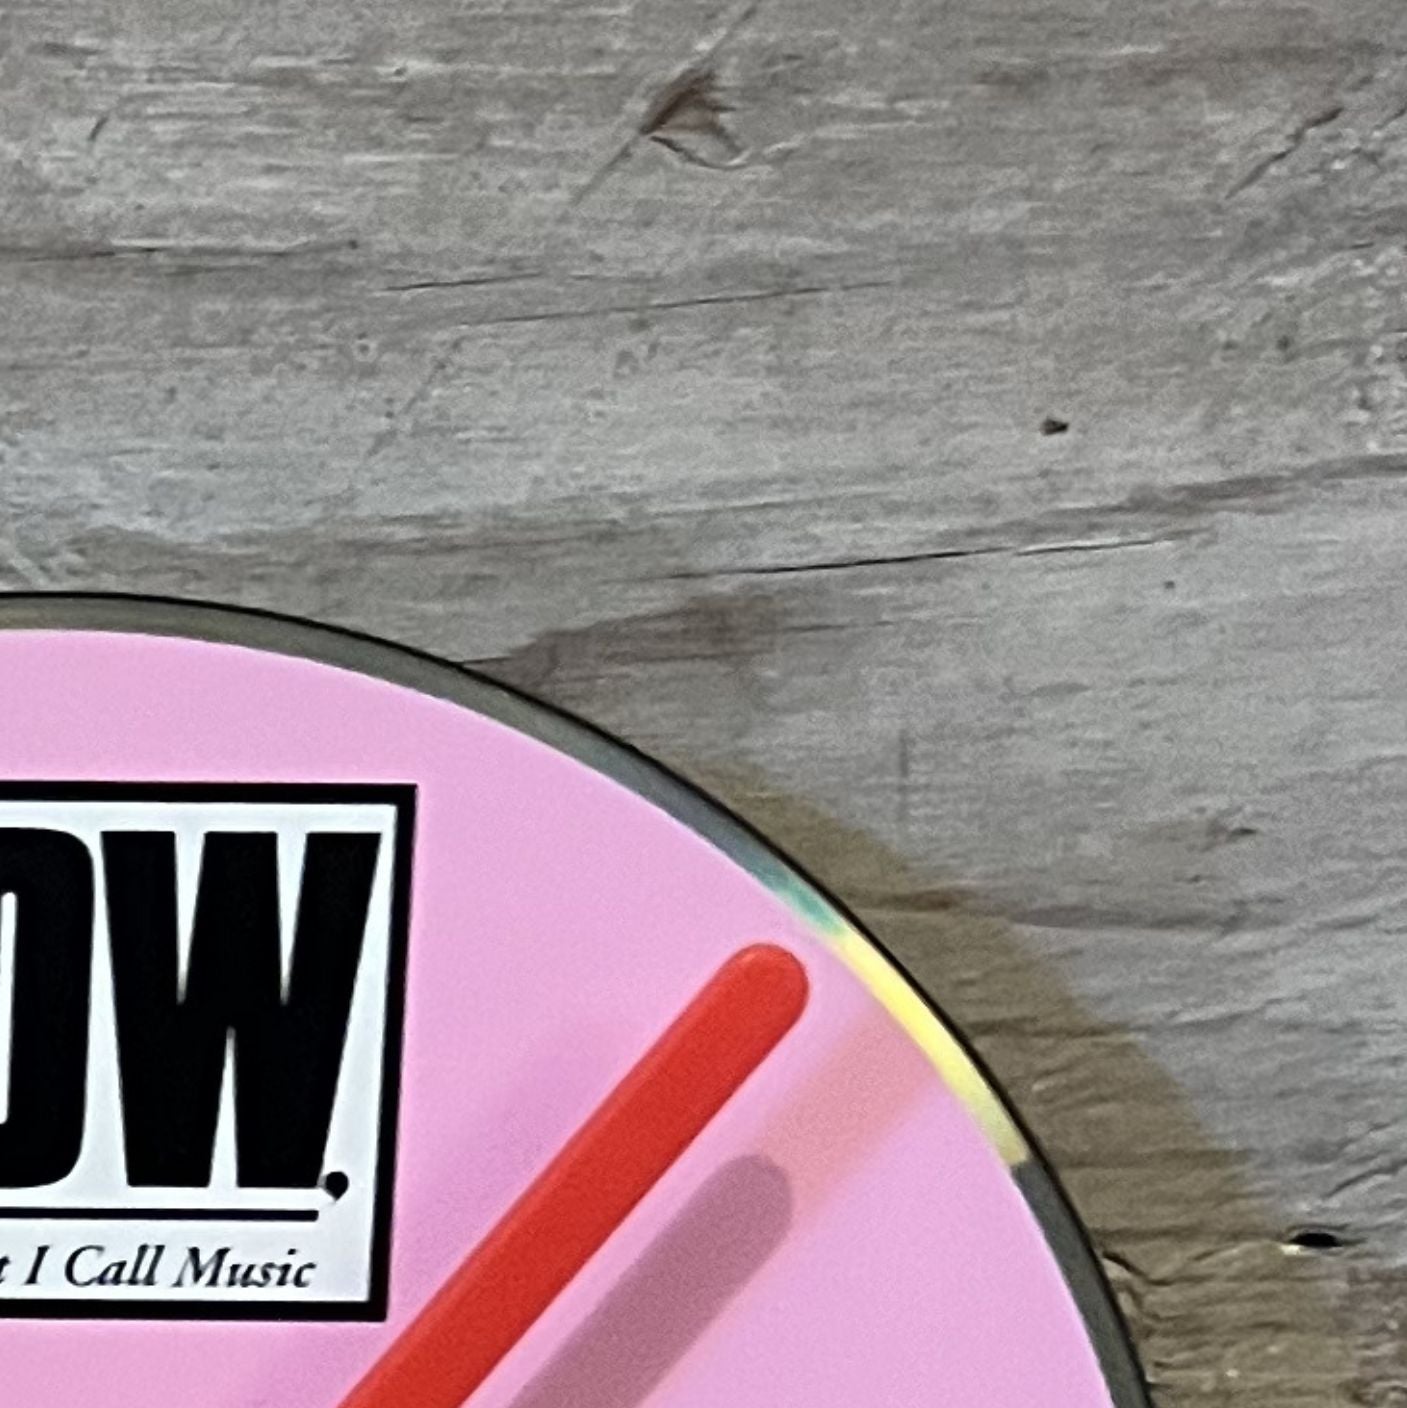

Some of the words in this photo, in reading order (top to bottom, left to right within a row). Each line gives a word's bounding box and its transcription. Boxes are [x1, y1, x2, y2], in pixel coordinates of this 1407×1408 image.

[23, 1246, 50, 1286] I
[65, 1244, 166, 1288] Call
[173, 1247, 319, 1289] Music
